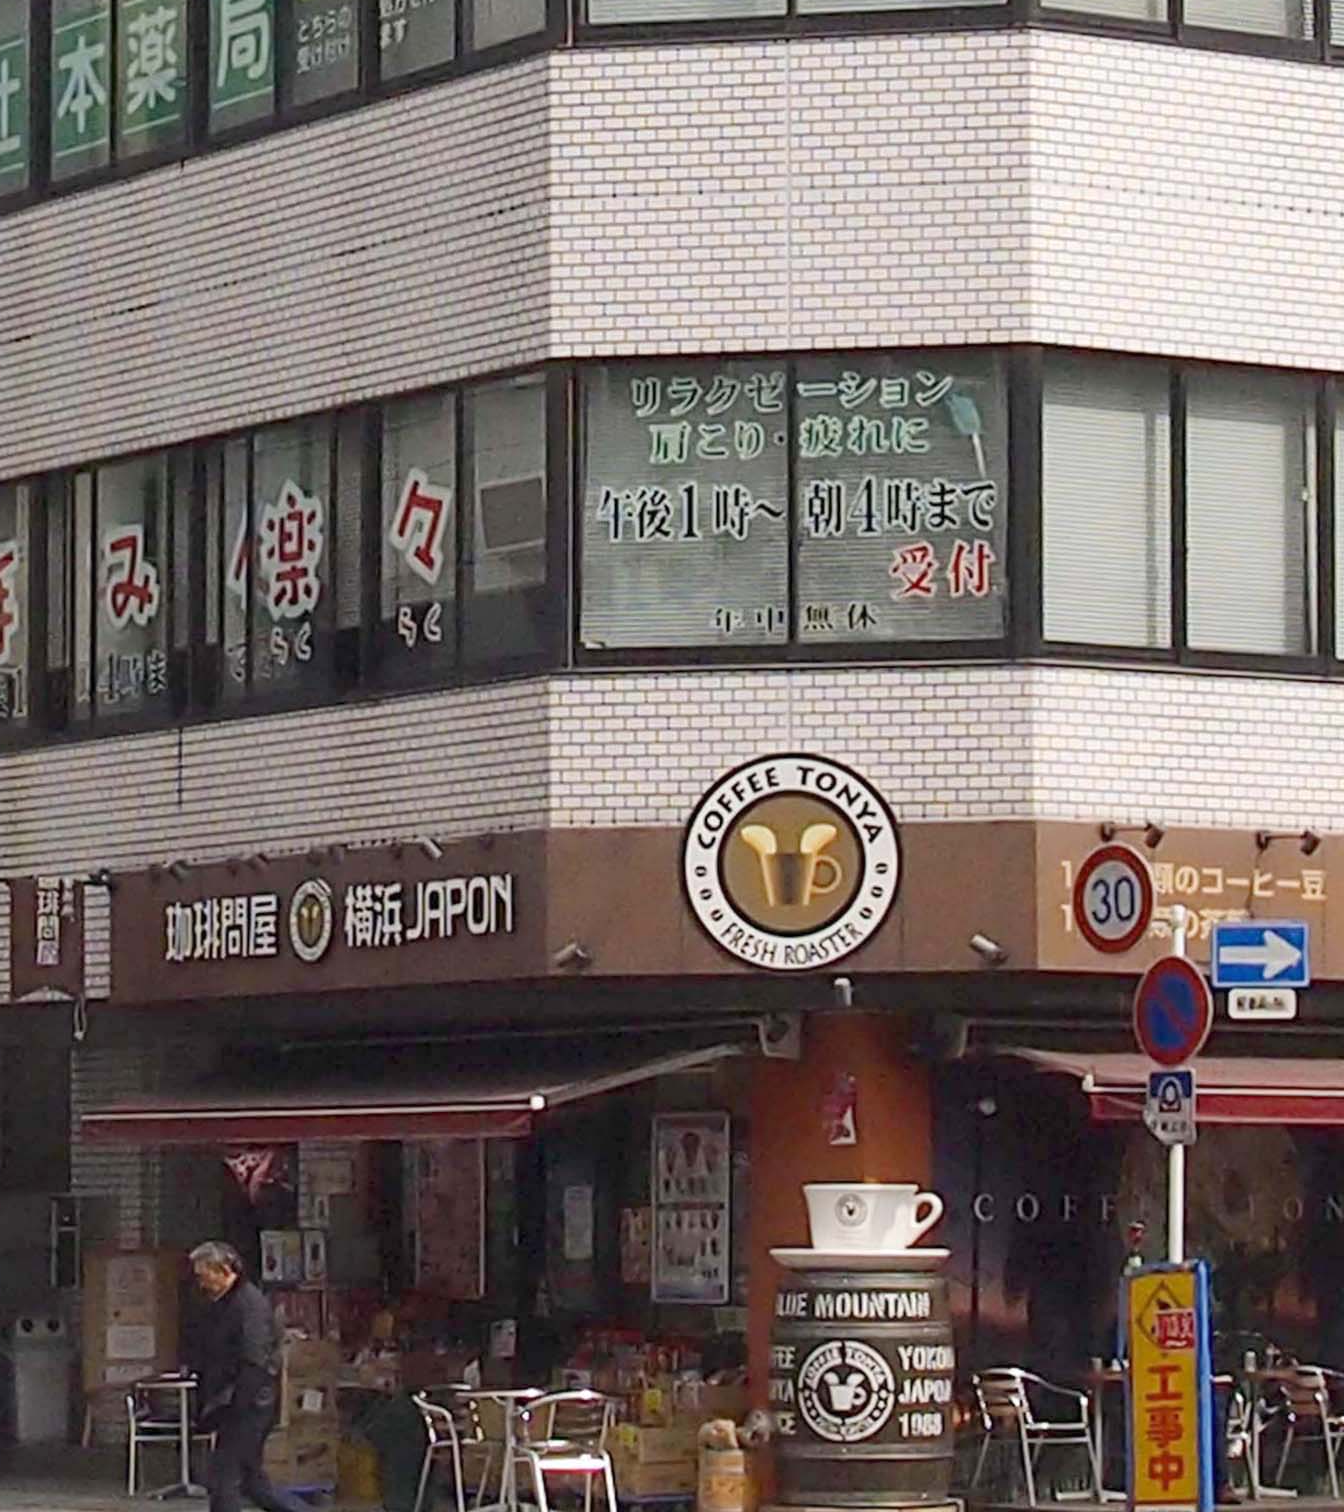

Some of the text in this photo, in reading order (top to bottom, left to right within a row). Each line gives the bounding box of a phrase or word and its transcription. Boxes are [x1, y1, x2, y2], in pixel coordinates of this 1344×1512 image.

[631, 371, 953, 416] リラクゼーション
[890, 541, 996, 598] 受付
[698, 766, 884, 850] COFFEE TONYA
[165, 873, 513, 962] 珈琲問屋 横浜 JAPON
[1091, 875, 1136, 925] 30
[720, 922, 863, 965] FRESH ROASTER
[775, 1291, 932, 1320] LUE MOUNTAIN
[1145, 1364, 1186, 1492] 工事中
